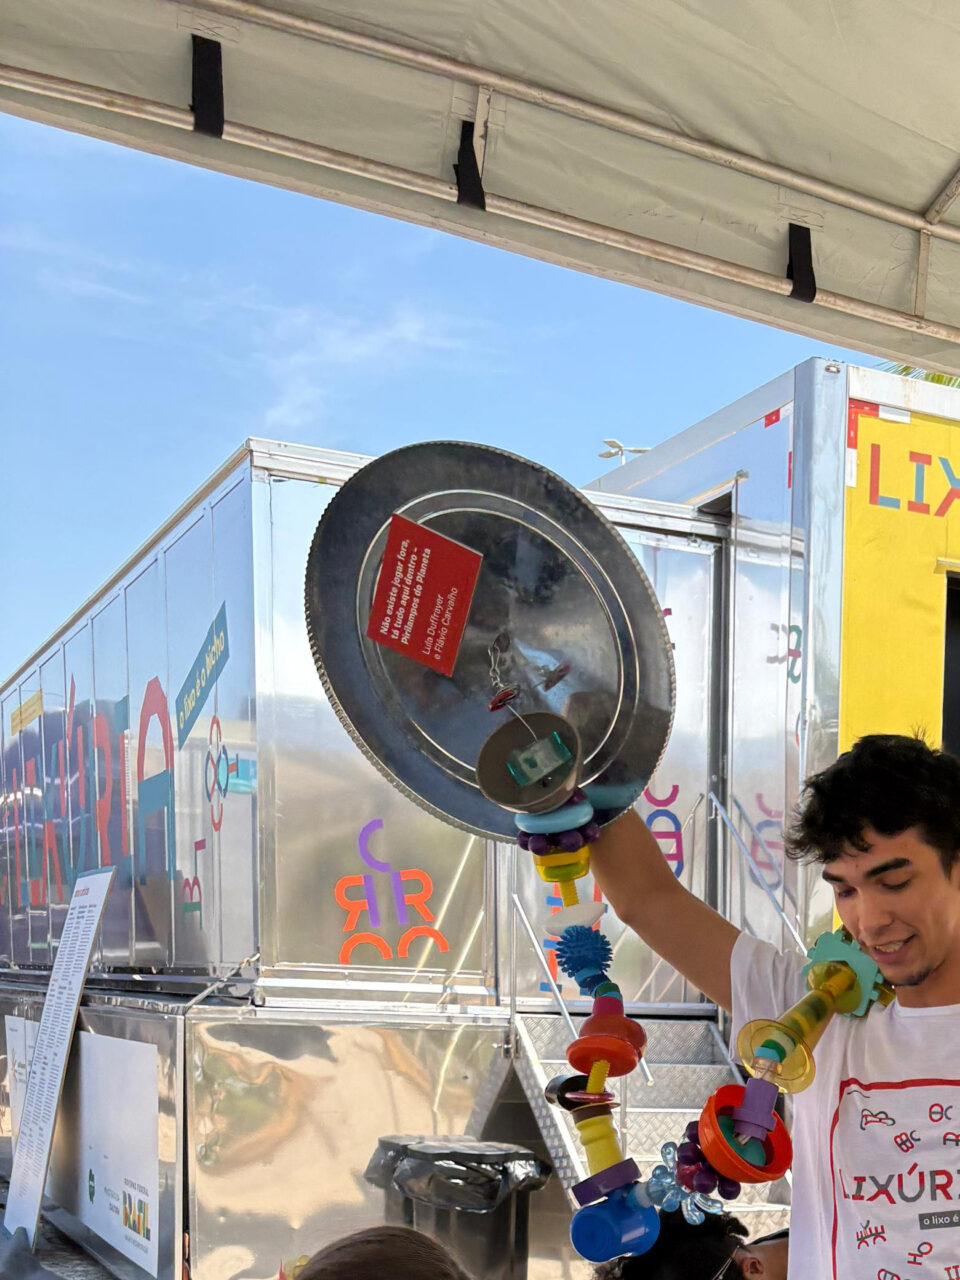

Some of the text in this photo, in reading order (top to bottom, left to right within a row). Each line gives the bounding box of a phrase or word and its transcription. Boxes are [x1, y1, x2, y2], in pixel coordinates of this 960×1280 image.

[404, 554, 417, 585] dentro
[380, 539, 410, 635] Não existe jogar fora,
[400, 585, 410, 605] aqui
[401, 548, 431, 645] Pirilampos do Planeta
[394, 607, 405, 627] tudo
[434, 627, 448, 652] Flávio
[441, 587, 458, 625] Carvalho
[391, 628, 399, 639] tá
[932, 1215, 950, 1225] lixo
[952, 1213, 959, 1223] é
